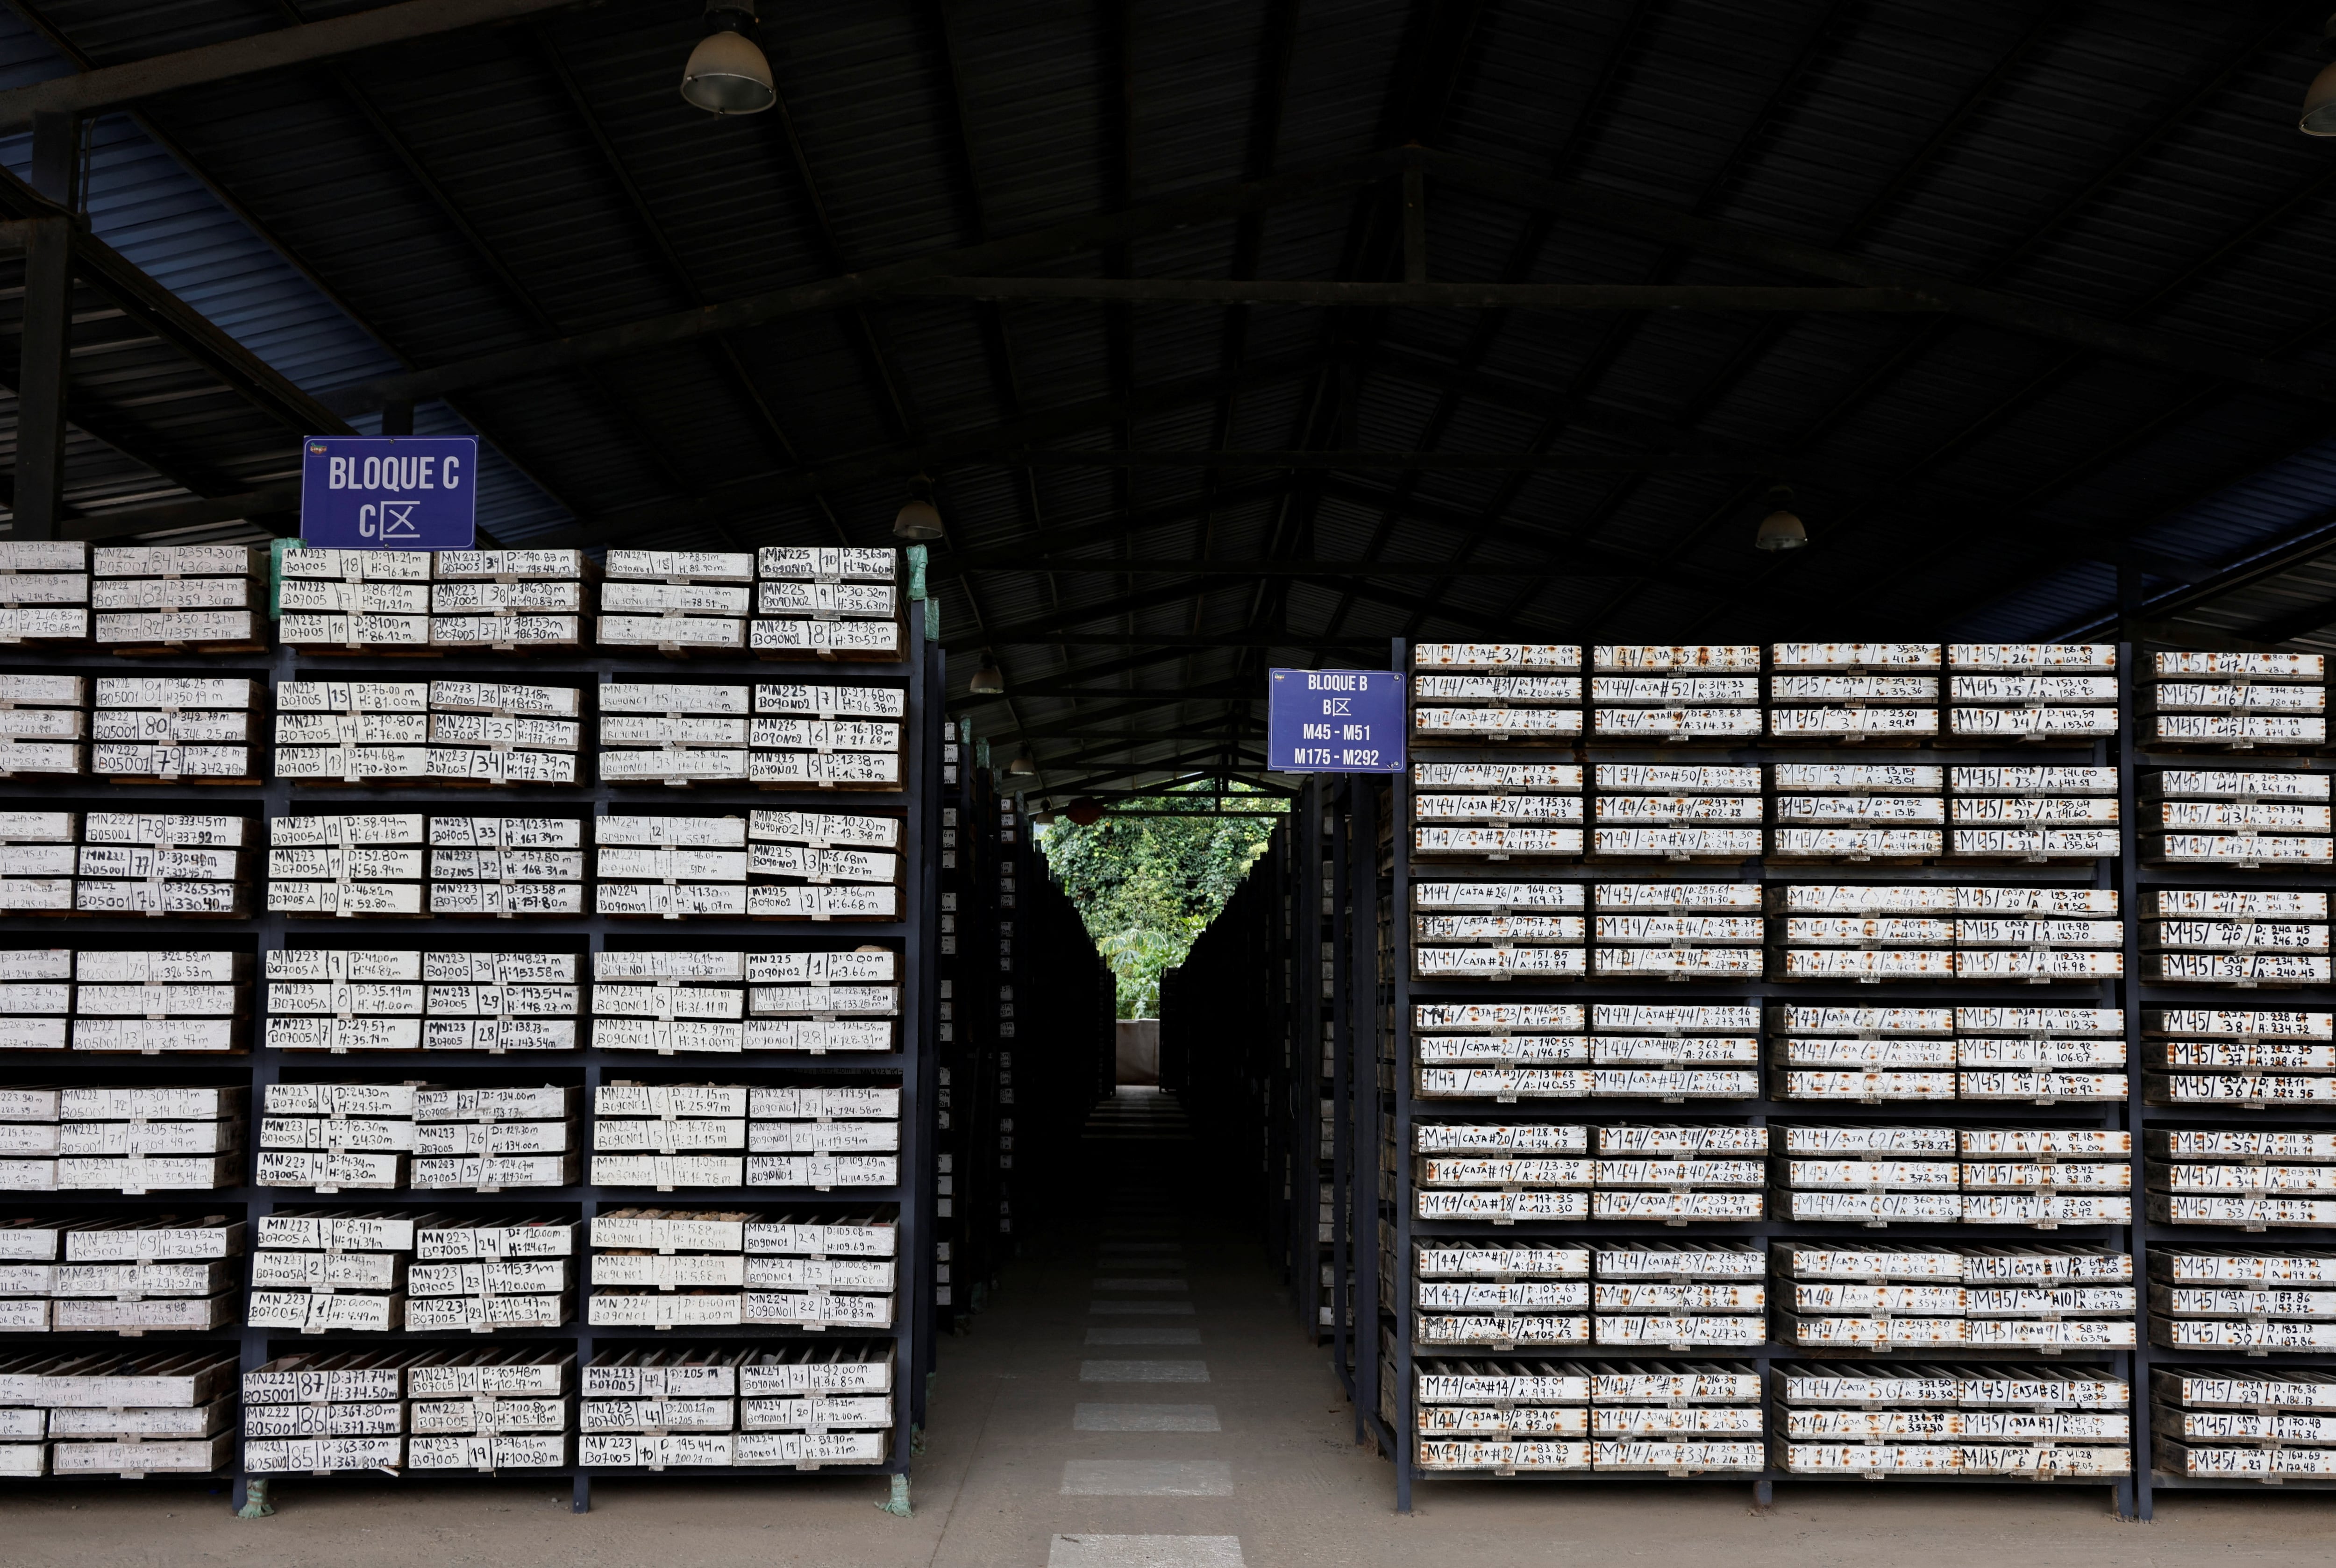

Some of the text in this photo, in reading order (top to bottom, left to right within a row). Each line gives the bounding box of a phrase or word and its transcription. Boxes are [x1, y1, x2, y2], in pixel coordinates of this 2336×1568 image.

[329, 456, 459, 492] BLOQUE C
[343, 558, 359, 572] 18
[765, 583, 805, 595] MN225
[820, 588, 826, 602] 9
[1308, 674, 1367, 692] BLOQUE B
[96, 725, 136, 738] B05001
[146, 716, 168, 735] 80
[1303, 724, 1331, 739] M45
[1343, 724, 1370, 740] M51
[1295, 748, 1330, 764] M175
[1343, 749, 1379, 765] M292
[93, 814, 134, 825] MN222
[434, 817, 468, 827] MN223
[141, 819, 164, 838] 78
[479, 827, 496, 839] 33
[91, 829, 131, 841] B05001
[275, 850, 315, 864] MN223
[600, 885, 638, 897] MN224
[655, 895, 668, 908] 10
[2215, 923, 2244, 931] CAJA
[2222, 931, 2241, 944] 40
[428, 953, 465, 964] MN223
[2222, 955, 2246, 964] CAJA
[474, 960, 490, 972] 30
[813, 960, 821, 975] 1
[2222, 965, 2243, 977] 39
[272, 1019, 313, 1030] MN223
[322, 1026, 329, 1042] 7
[2015, 1049, 2026, 1060] 16
[2217, 1044, 2246, 1054] CAJA
[2225, 1053, 2242, 1066] 37
[601, 1088, 641, 1100] MN224
[63, 1125, 100, 1136] MN222
[412, 1267, 457, 1280] MN223
[466, 1277, 479, 1288] 23
[748, 1294, 788, 1305] MN224
[2220, 1291, 2245, 1300] CAJA
[801, 1301, 815, 1312] 22
[2230, 1301, 2244, 1313] 31
[245, 1372, 295, 1385] MN222
[301, 1373, 324, 1396] 87
[244, 1389, 295, 1404] B05001
